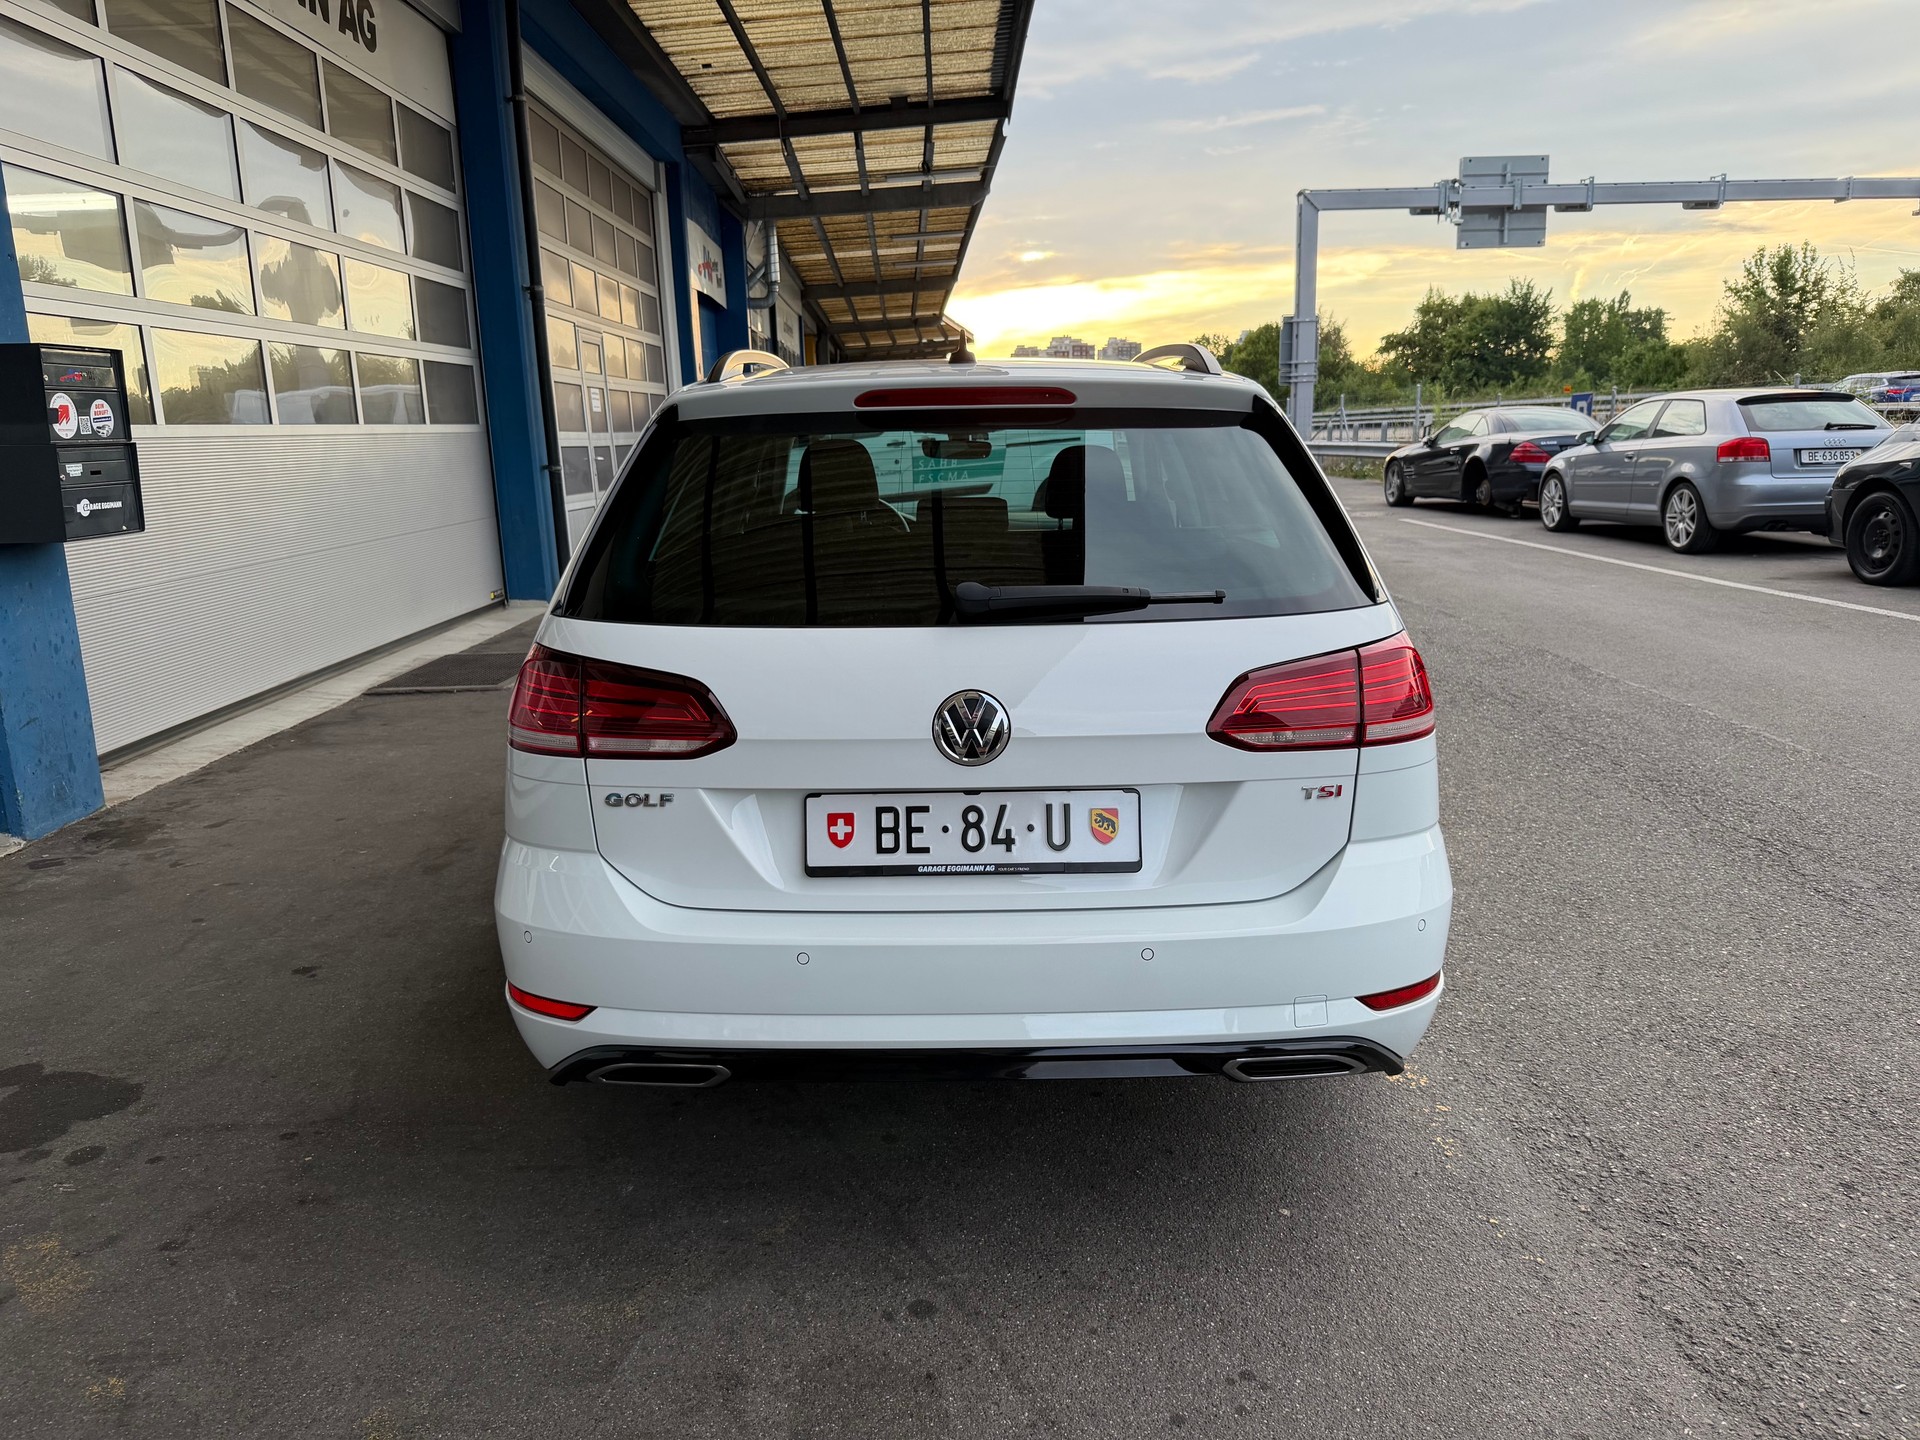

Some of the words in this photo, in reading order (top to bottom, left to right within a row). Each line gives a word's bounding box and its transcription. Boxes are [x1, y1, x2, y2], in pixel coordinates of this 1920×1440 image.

[338, 0, 377, 53] AG
[604, 792, 675, 808] GOLF
[1301, 784, 1343, 800] TSI
[917, 865, 947, 873] GARAGE
[984, 864, 996, 872] AG
